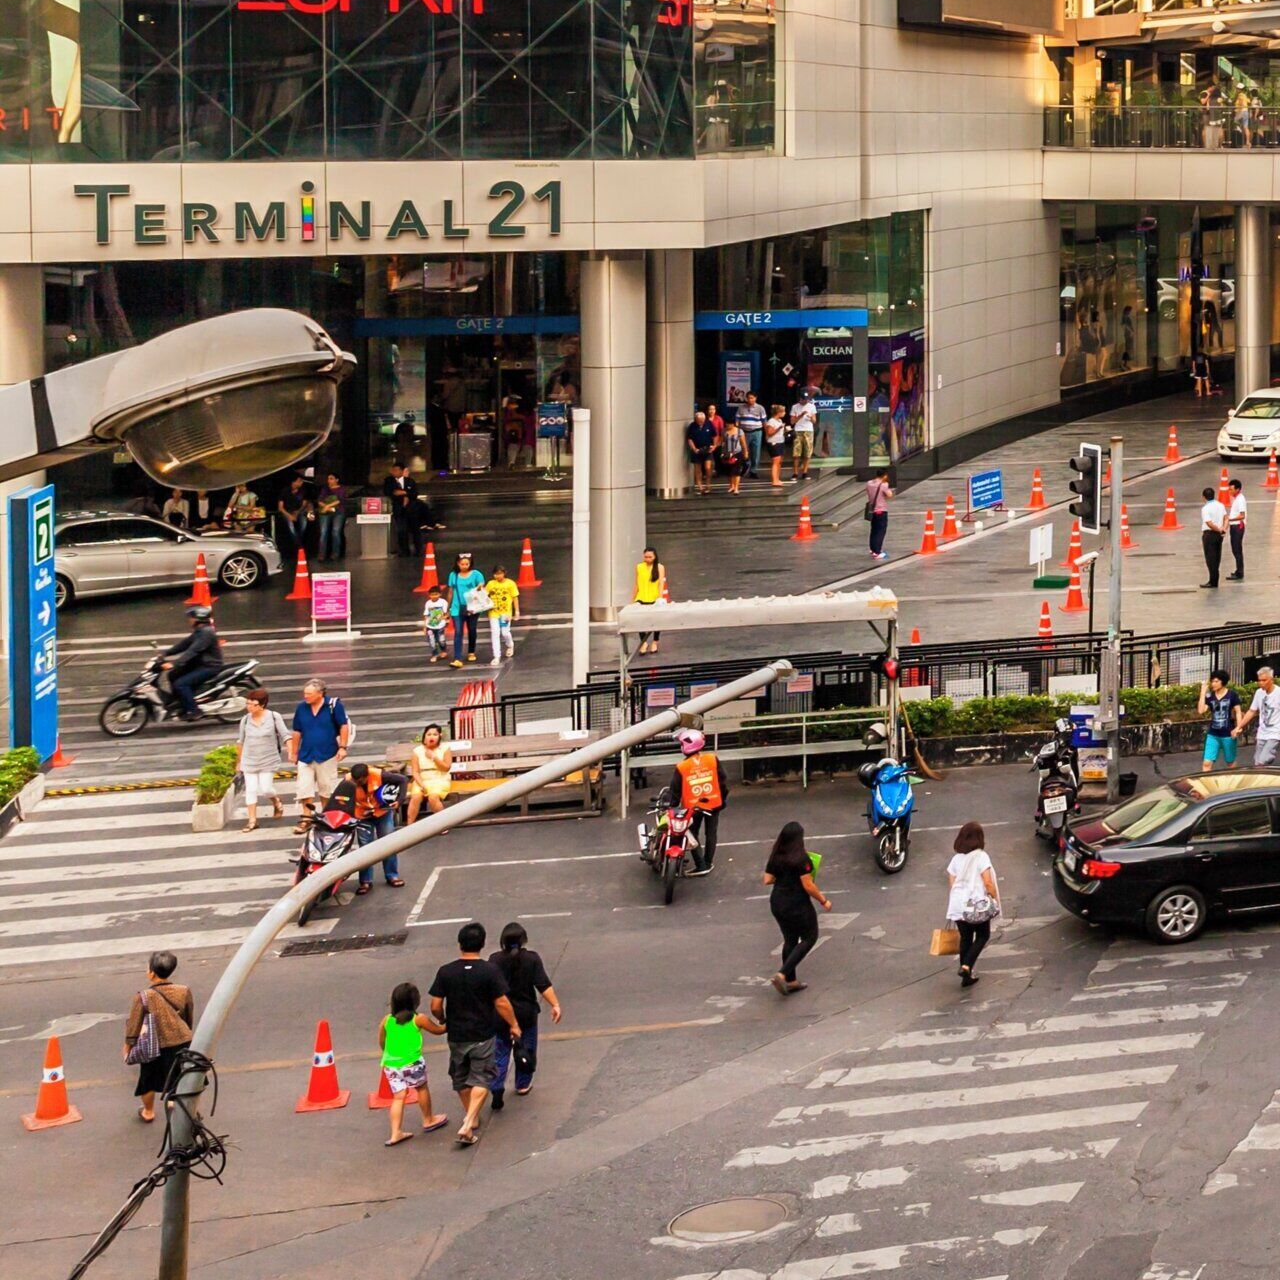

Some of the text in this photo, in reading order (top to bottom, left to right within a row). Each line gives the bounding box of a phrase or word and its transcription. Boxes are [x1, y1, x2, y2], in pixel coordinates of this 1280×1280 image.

[486, 179, 563, 237] 21
[456, 317, 504, 330] GATE 2
[725, 312, 772, 325] GATE 2
[37, 521, 49, 559] 2
